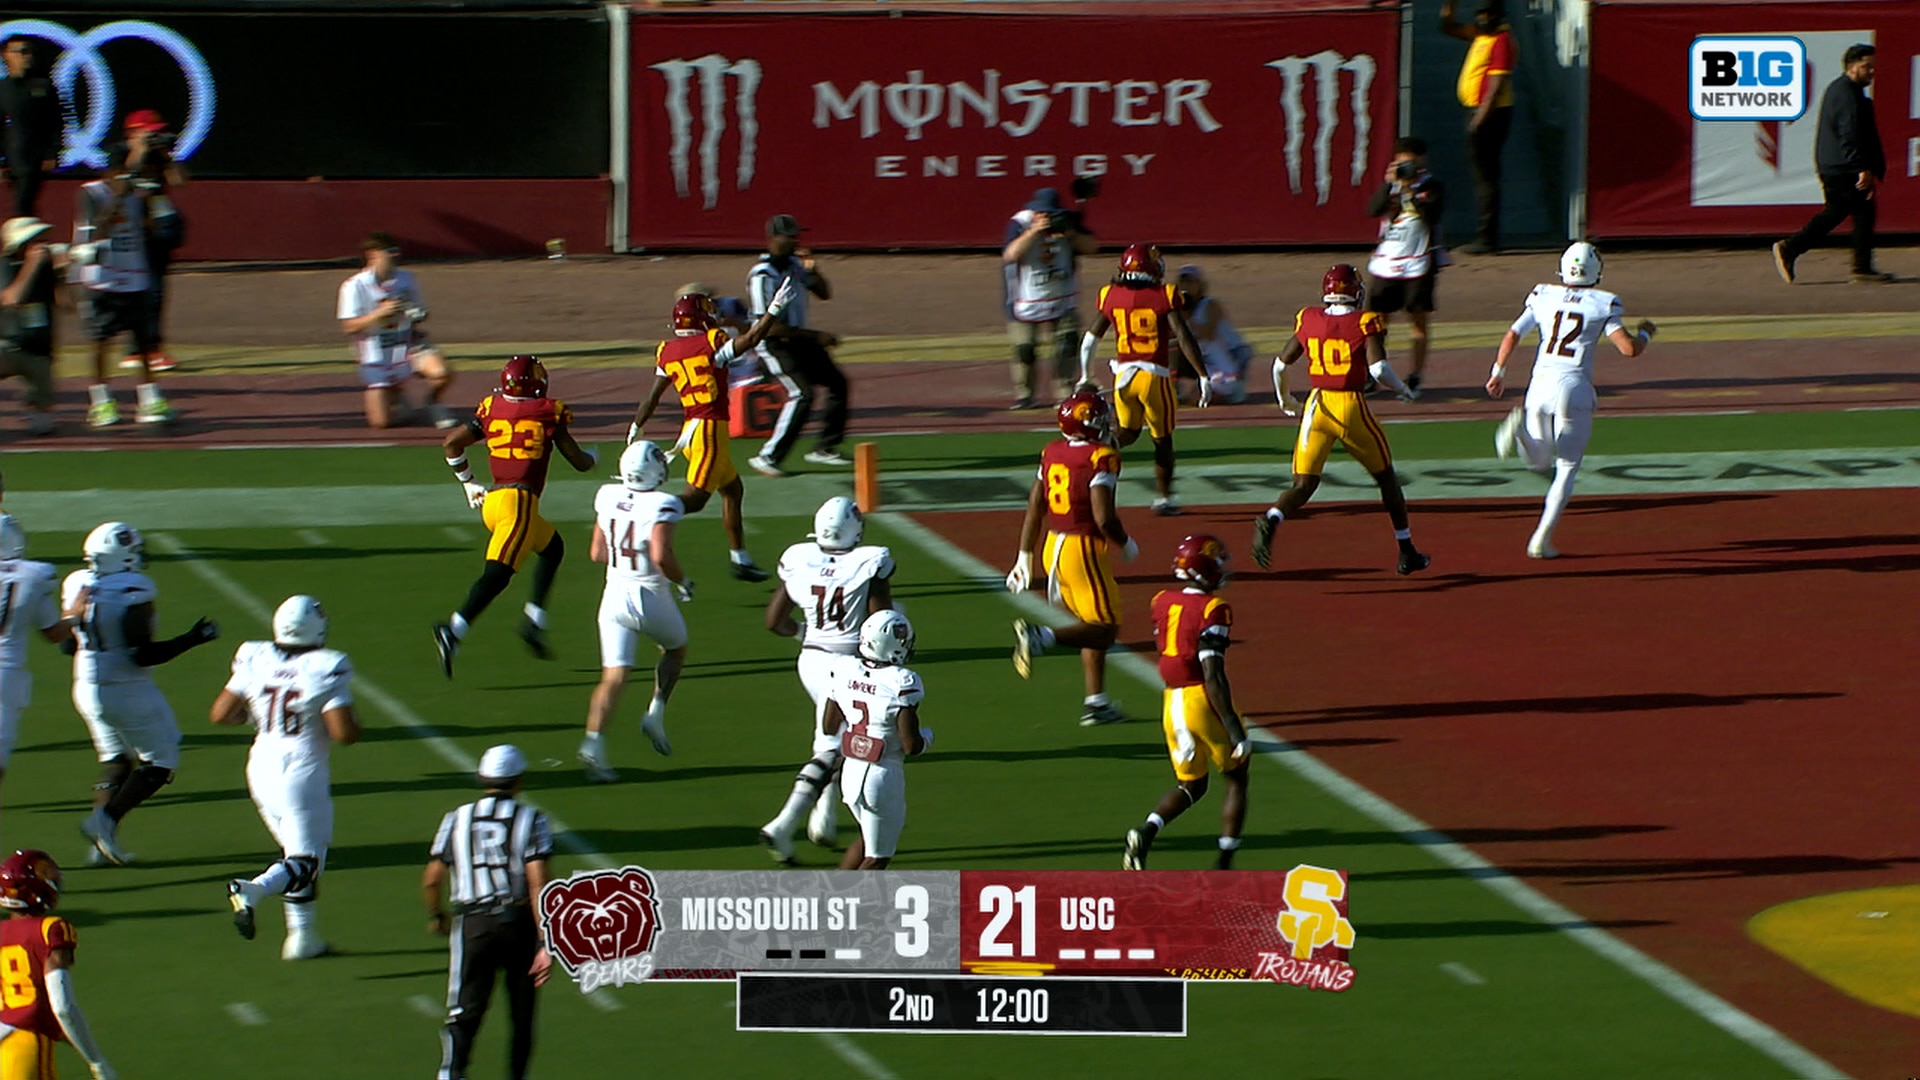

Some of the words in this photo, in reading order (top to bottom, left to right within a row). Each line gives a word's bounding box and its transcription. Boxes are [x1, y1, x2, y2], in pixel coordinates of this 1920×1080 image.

[812, 69, 1222, 141] MONSTER
[874, 153, 1156, 178] ENERGY
[1112, 307, 1159, 355] 19
[1546, 310, 1585, 358] 12
[1306, 337, 1352, 376] 10
[664, 354, 719, 408] 25
[747, 391, 780, 432] G
[487, 419, 545, 460] 23
[1047, 463, 1071, 516] 8
[609, 517, 639, 572] 14
[810, 584, 846, 632] 74
[1162, 604, 1184, 658] 1
[262, 686, 304, 736] 76
[470, 820, 510, 868] R
[0, 944, 37, 1012] 8
